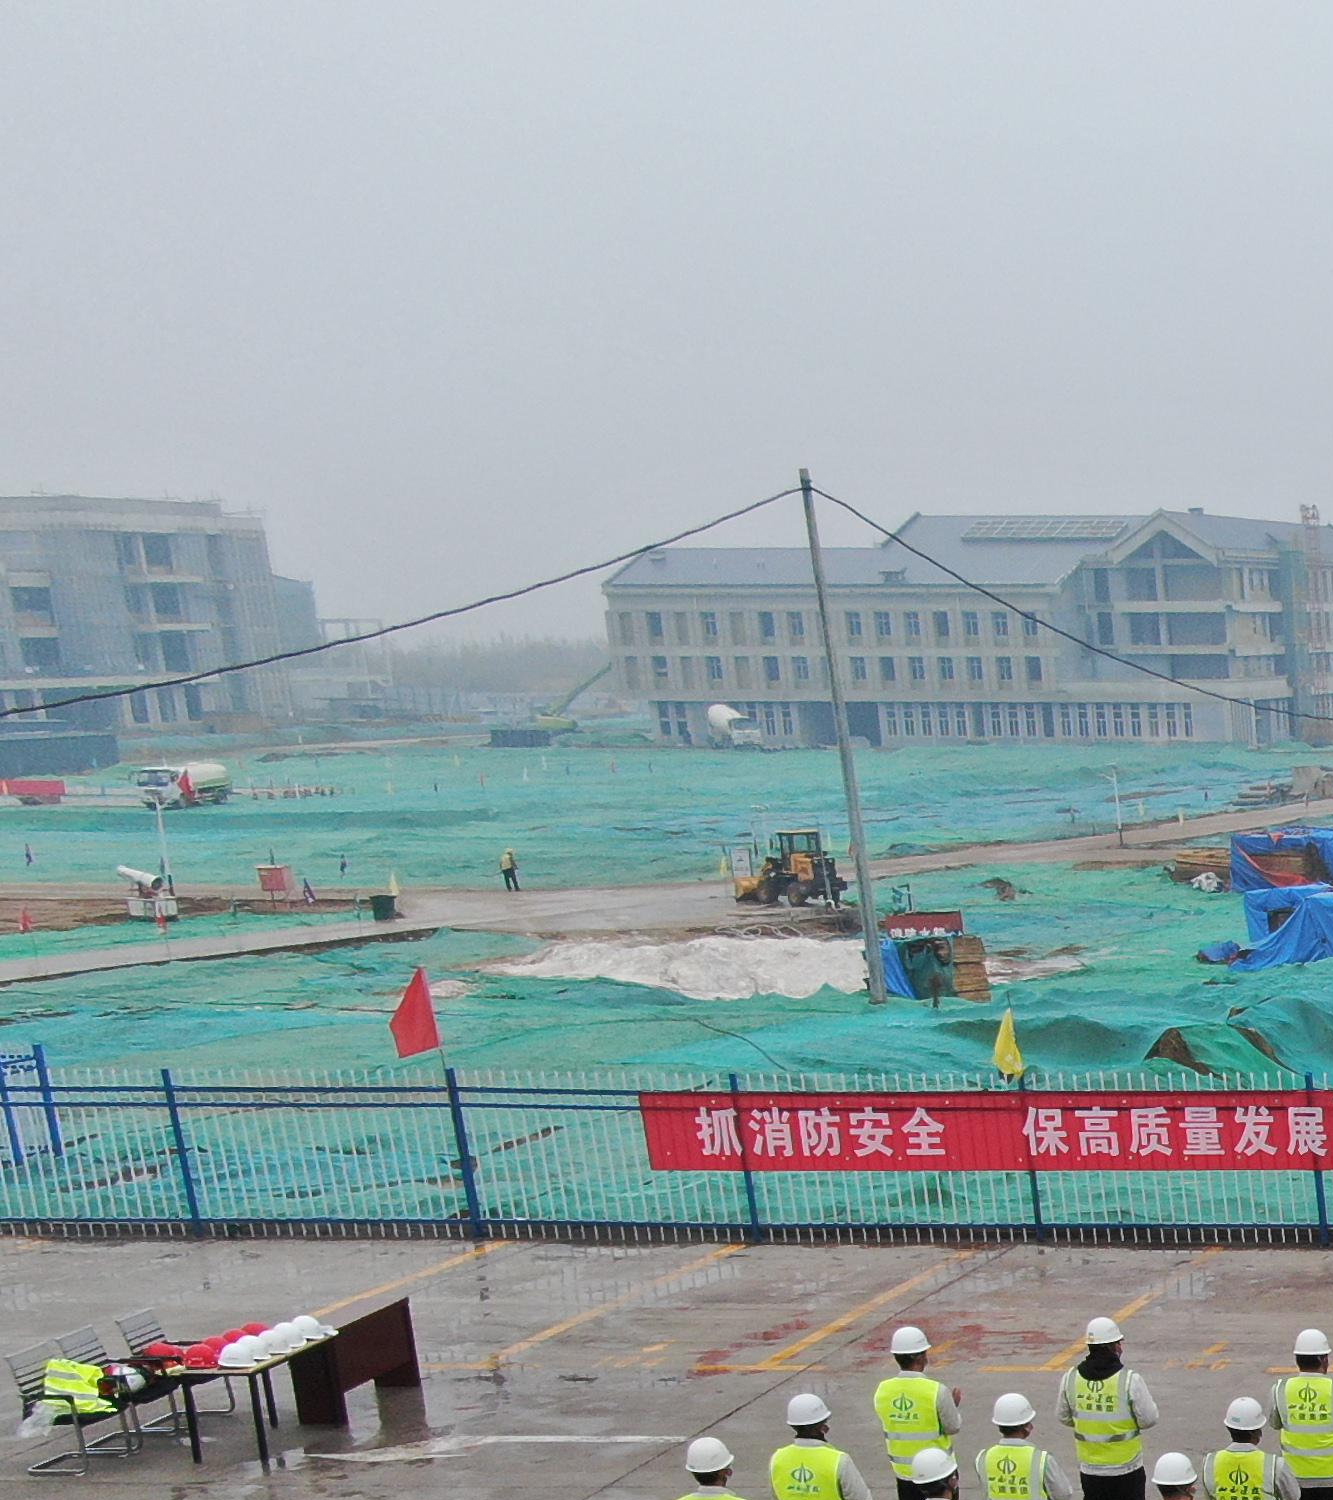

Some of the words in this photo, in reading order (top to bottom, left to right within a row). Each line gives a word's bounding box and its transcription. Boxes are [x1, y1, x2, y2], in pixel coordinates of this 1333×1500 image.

[695, 1106, 947, 1159] 抓消防安全
[1022, 1105, 1329, 1158] 保高质量发展
